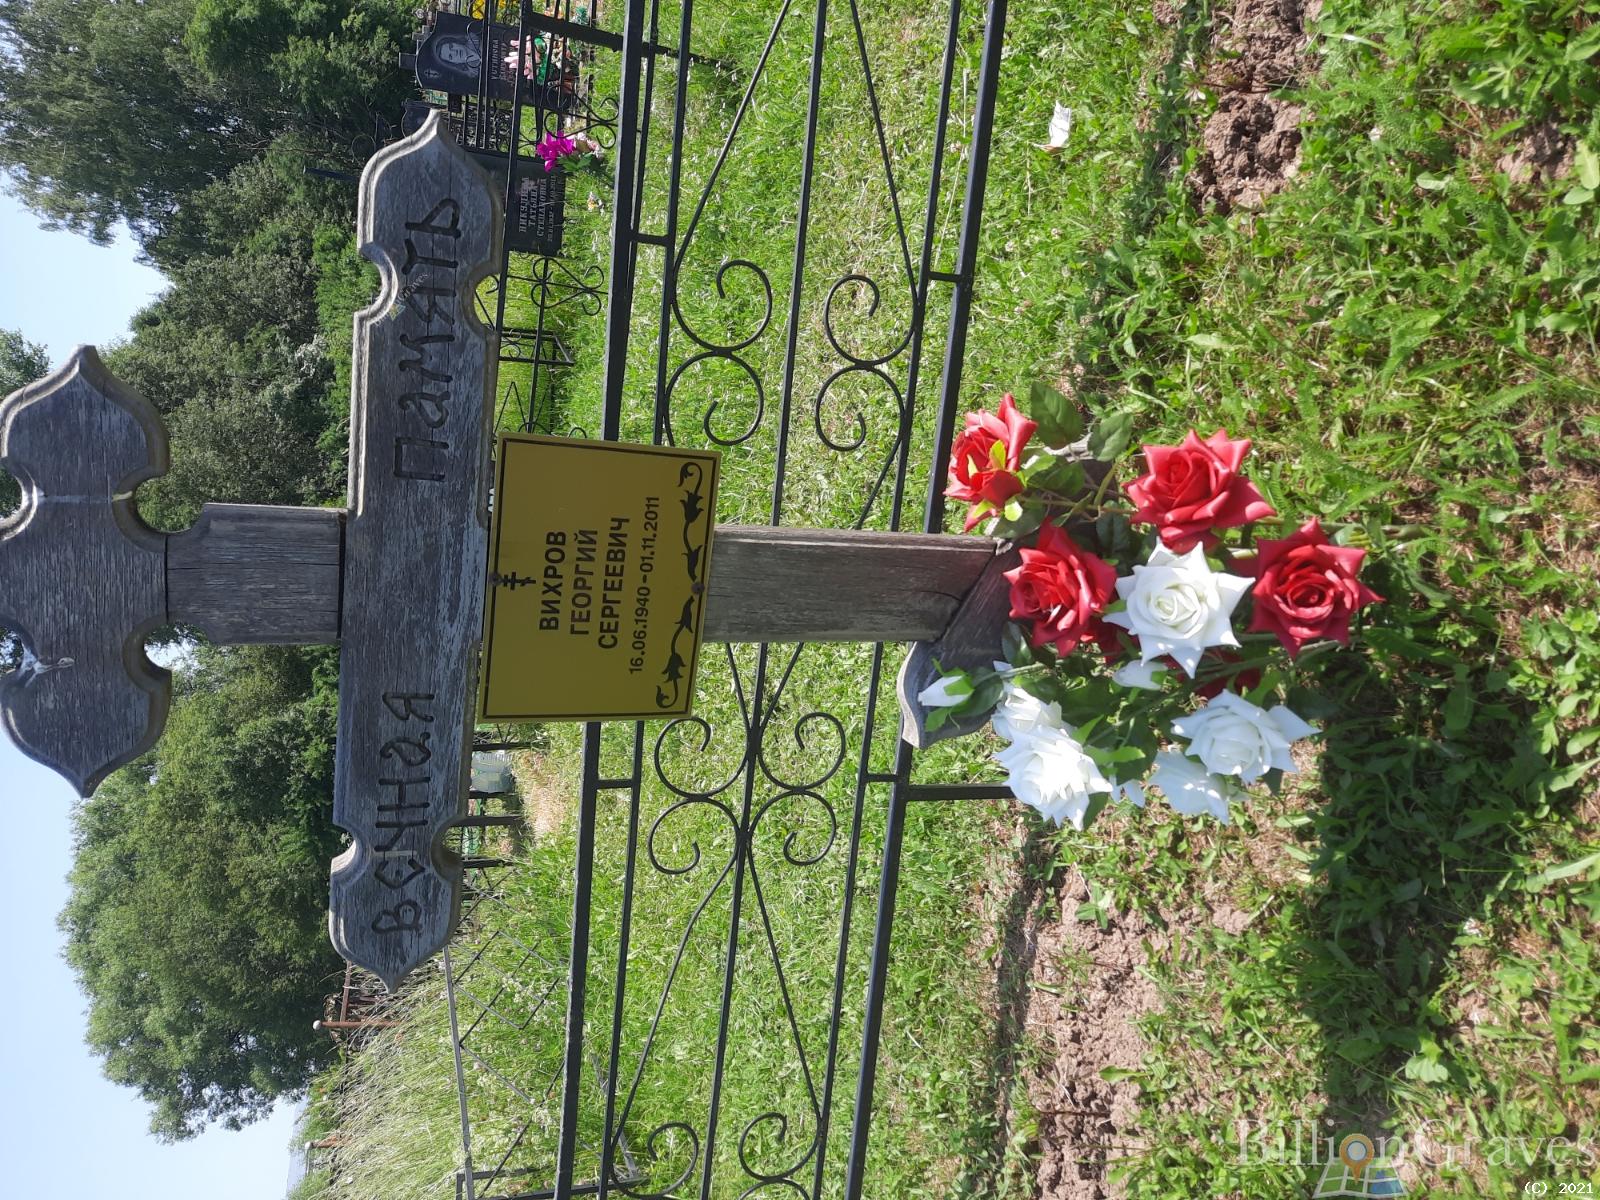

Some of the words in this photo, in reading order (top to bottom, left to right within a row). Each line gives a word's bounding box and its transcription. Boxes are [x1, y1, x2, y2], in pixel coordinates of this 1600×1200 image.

[528, 185, 538, 227] ТАТЬЯНА
[536, 178, 547, 237] СТЕПАНОВНА
[539, 531, 567, 630] ВИХРОВ
[570, 529, 598, 635] ГЕОРГИЙ
[597, 517, 630, 649] СЕРГЕЕВИЧ
